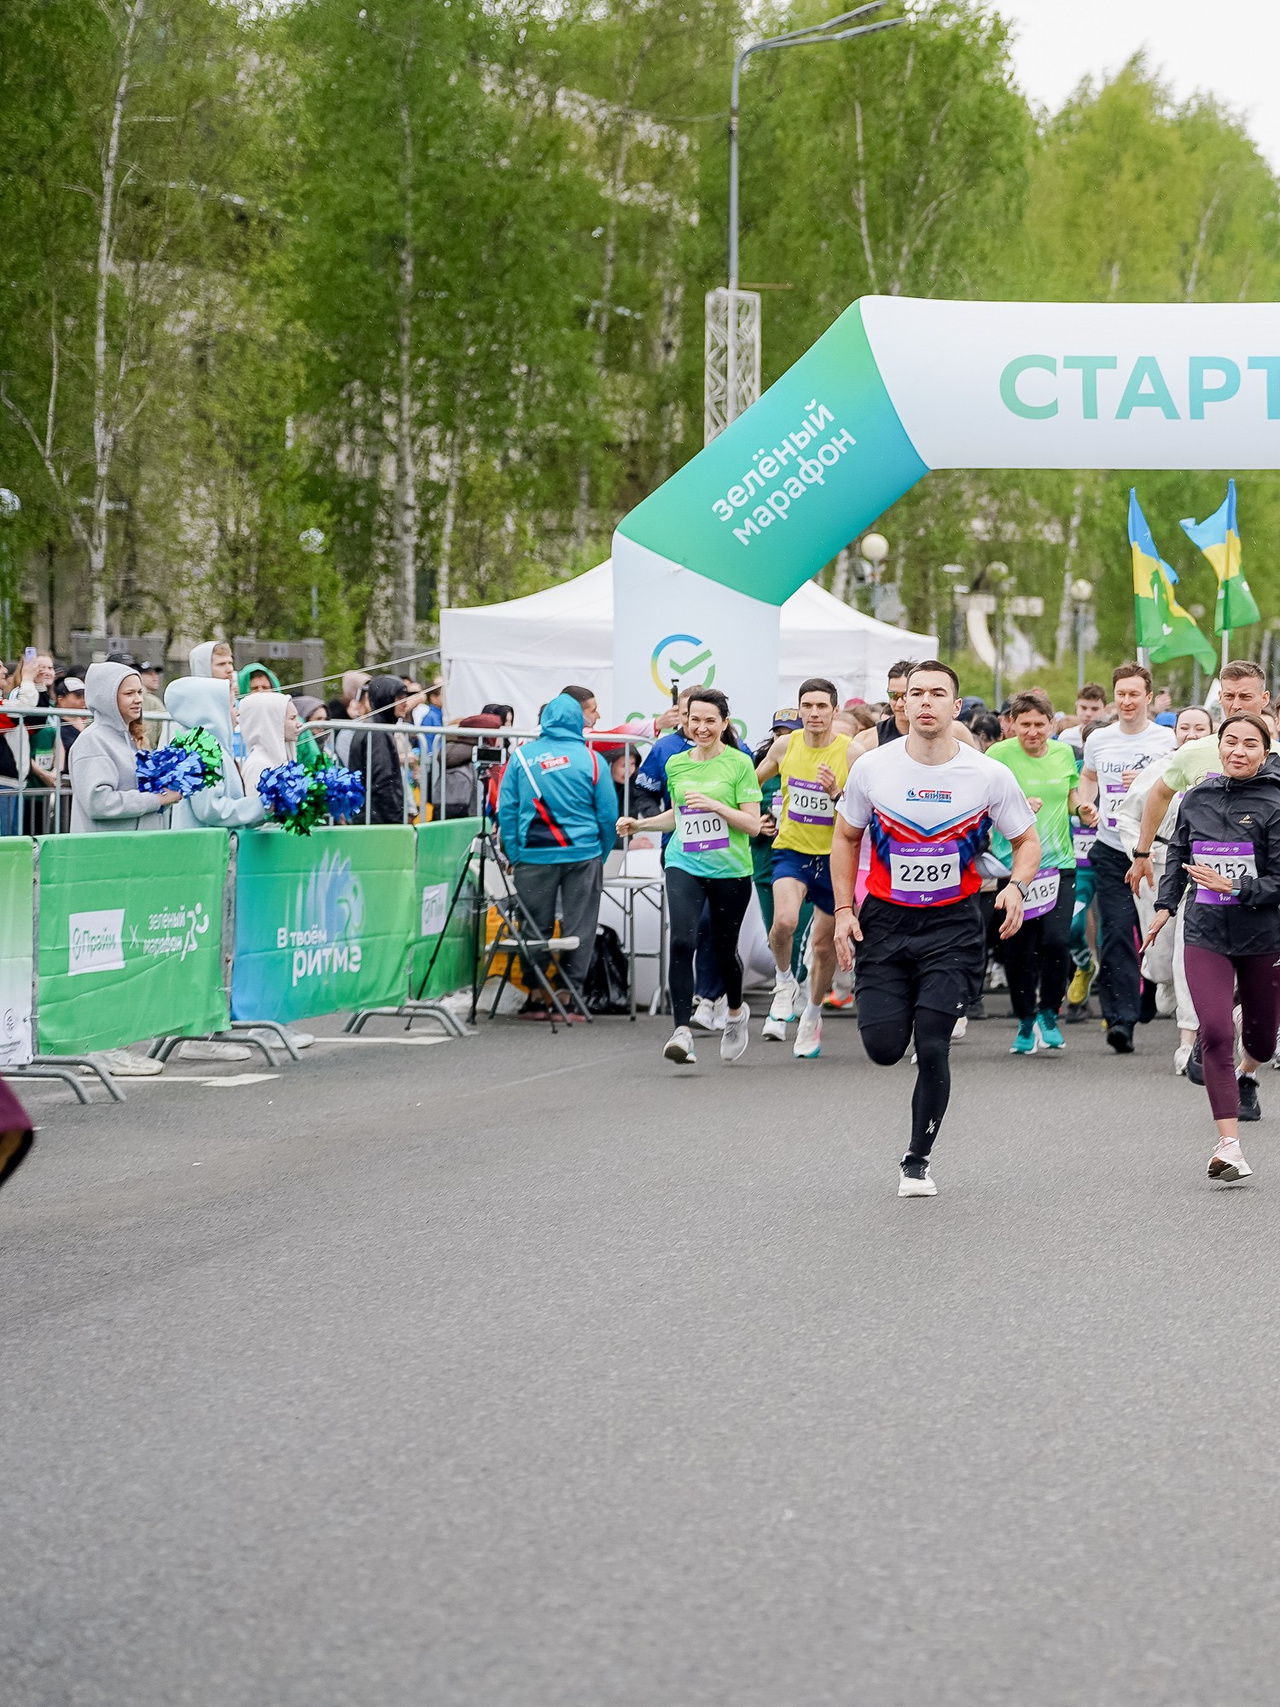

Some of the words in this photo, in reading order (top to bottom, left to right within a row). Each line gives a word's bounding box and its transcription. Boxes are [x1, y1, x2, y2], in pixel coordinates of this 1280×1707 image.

[711, 398, 835, 522] зелёный
[732, 427, 857, 546] марафон
[793, 793, 828, 811] 2055
[684, 818, 722, 836] 2100
[899, 863, 952, 882] 2289
[276, 927, 289, 949] В
[289, 923, 328, 947] твоём
